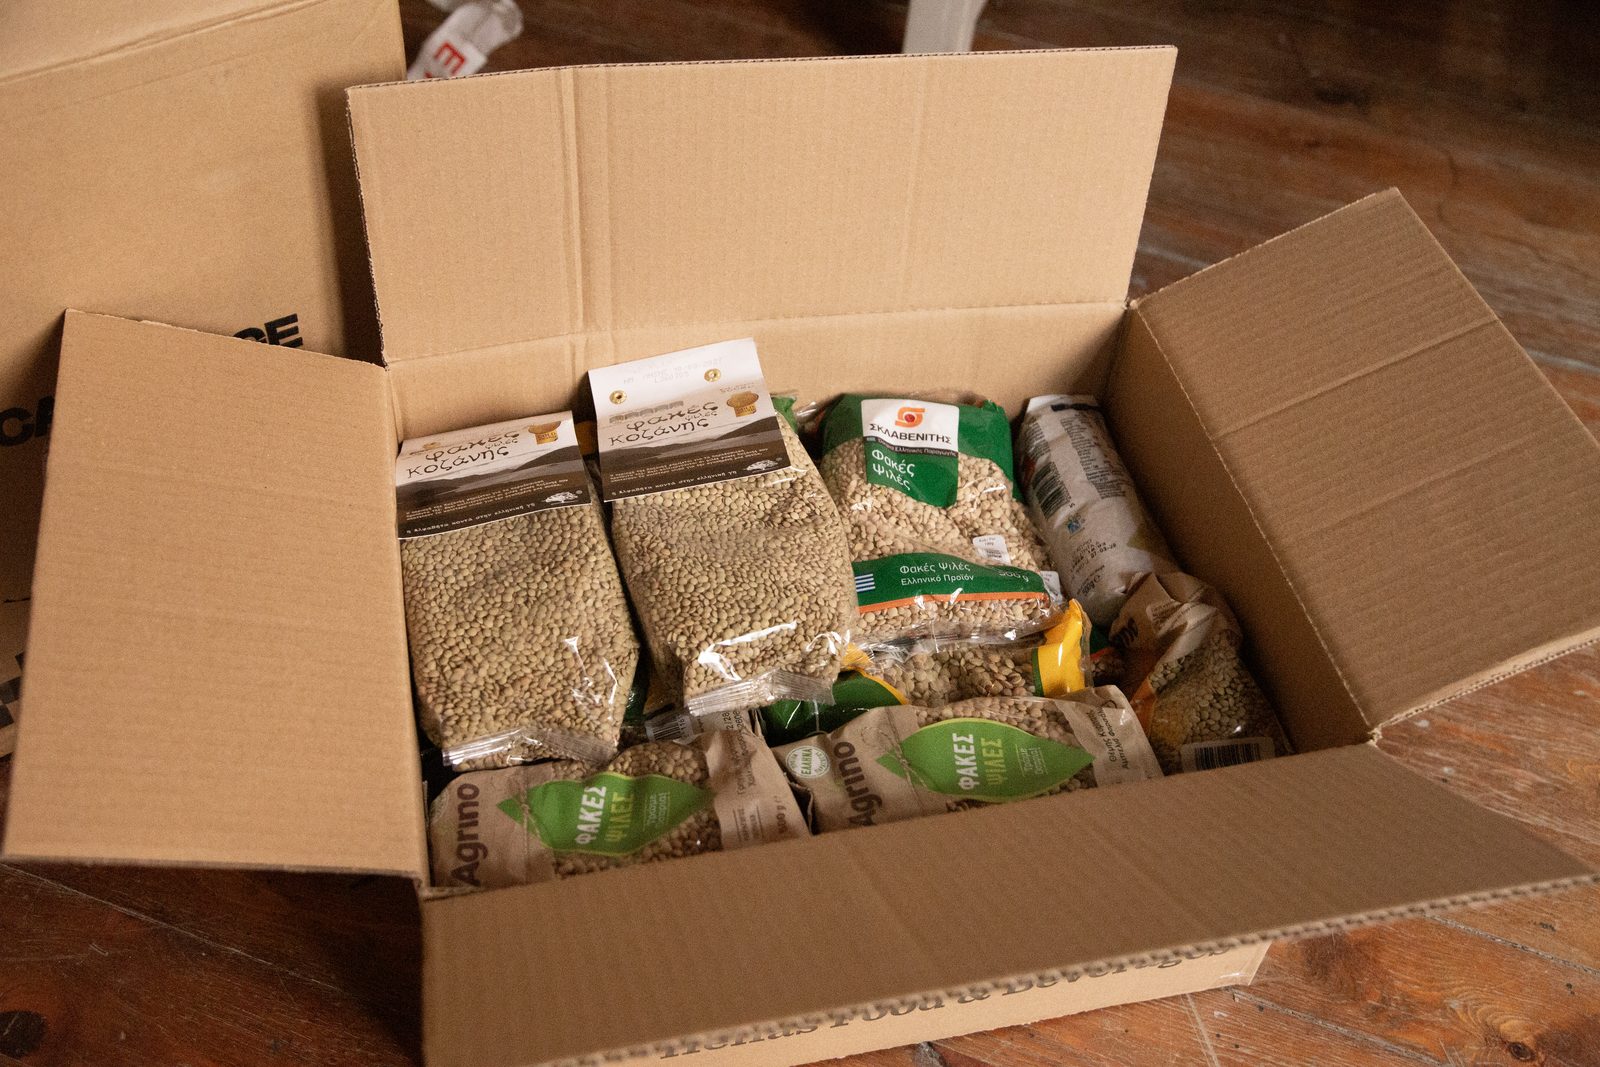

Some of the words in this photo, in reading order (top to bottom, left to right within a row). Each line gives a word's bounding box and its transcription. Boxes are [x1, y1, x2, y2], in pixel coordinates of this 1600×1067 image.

[869, 423, 952, 444] ΣΚΛΑΒΕΝΙΤΗΣ
[871, 449, 915, 477] Φακές
[872, 463, 911, 491] Ψιλές
[899, 563, 936, 574] Φακές
[938, 562, 971, 573] Ψιλές
[901, 575, 942, 586] Ελληνικό
[943, 573, 974, 583] Προϊόν
[952, 733, 981, 790] ΦΑΚΕΣ
[981, 737, 1008, 786] ΨΙΛΕΣ
[834, 742, 883, 826] Agrino
[451, 783, 488, 886] Agrino
